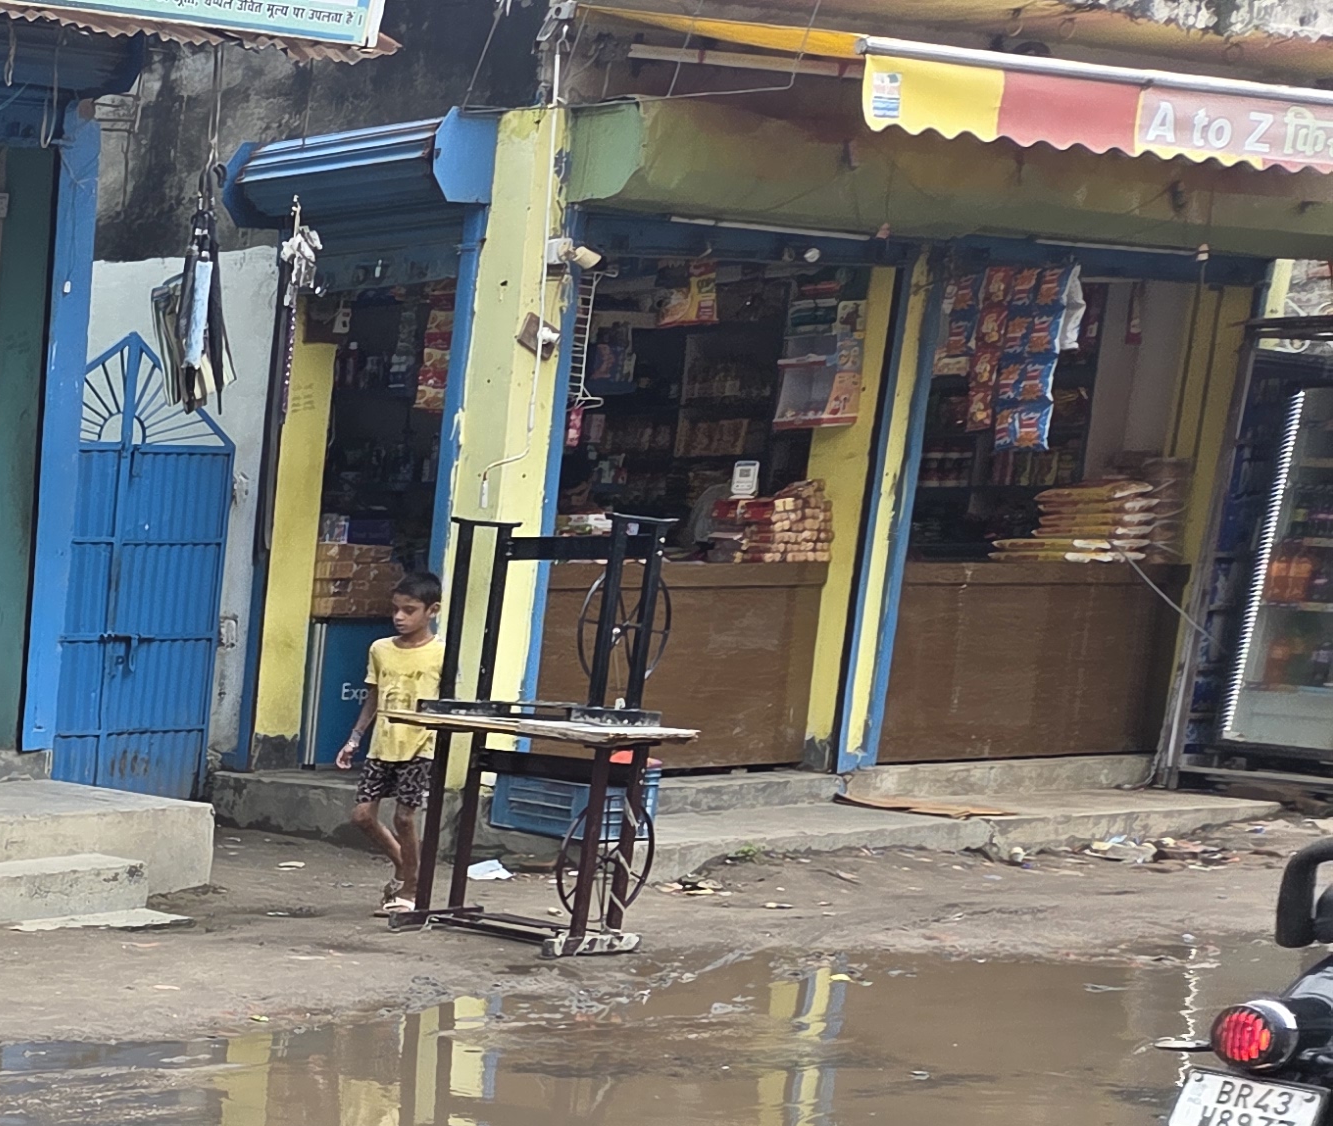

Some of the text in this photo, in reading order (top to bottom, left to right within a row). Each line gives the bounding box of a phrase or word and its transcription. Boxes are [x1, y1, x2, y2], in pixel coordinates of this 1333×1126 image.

[266, 4, 290, 18] मूल्य
[293, 7, 306, 19] पर
[1145, 101, 1333, 157] A to Z कि
[341, 682, 369, 705] Exp
[1216, 1080, 1295, 1115] BR43
